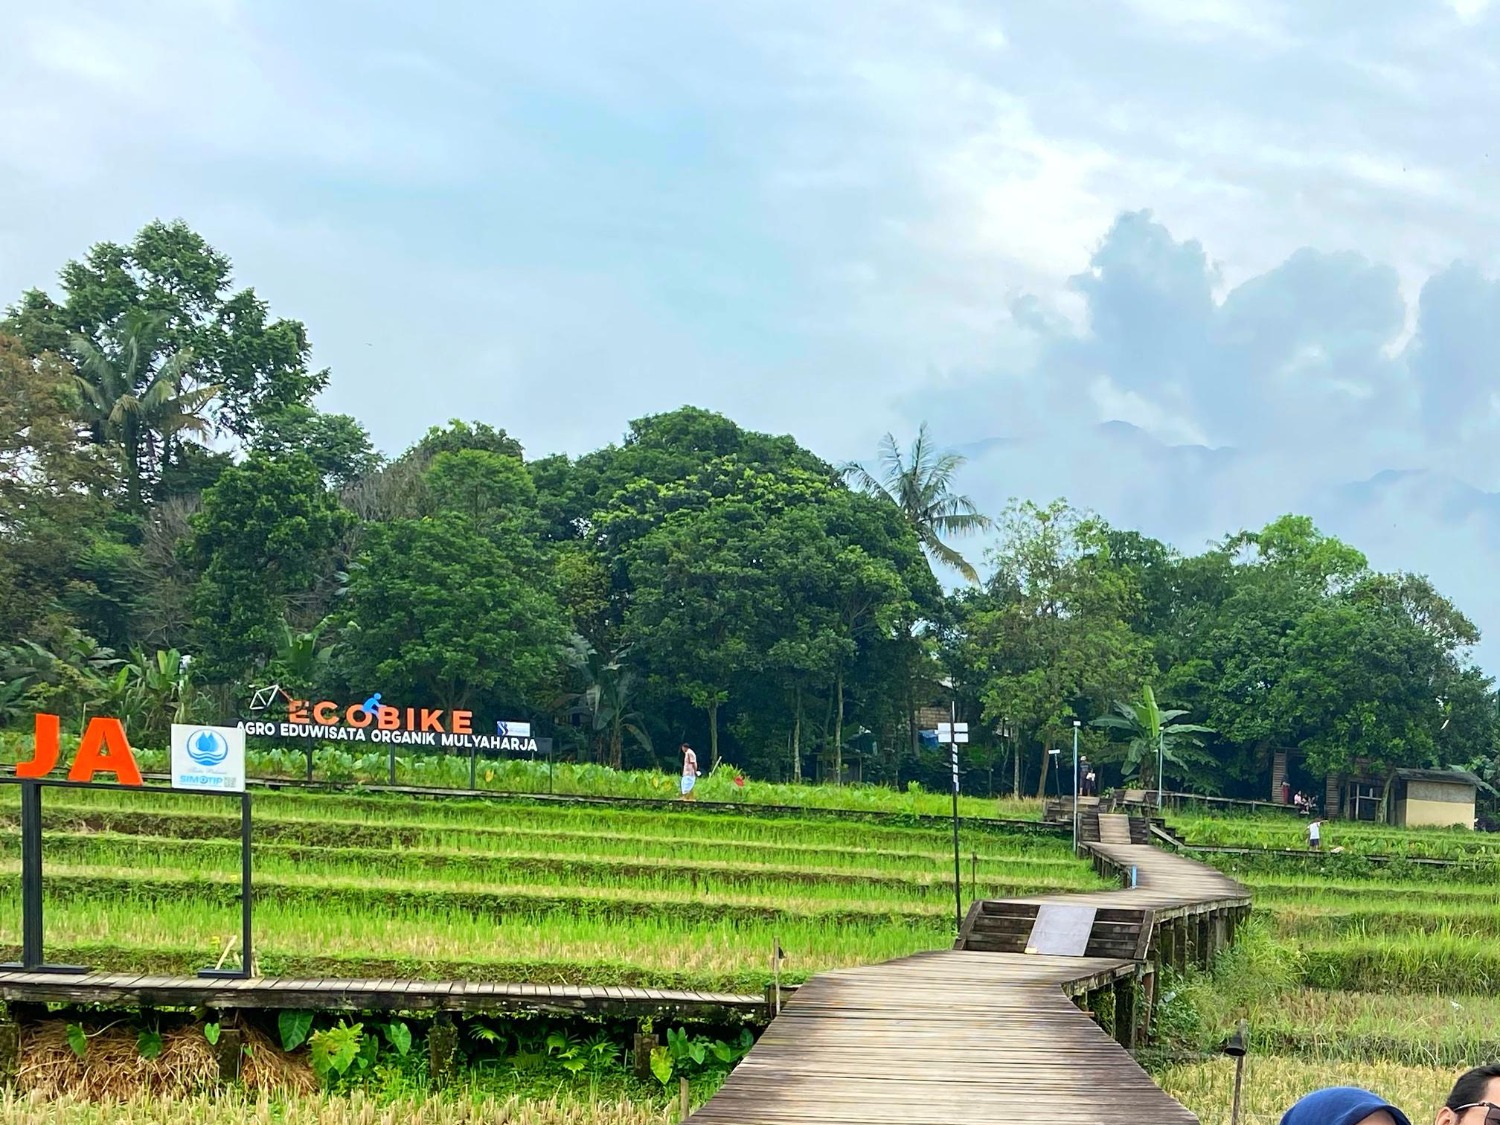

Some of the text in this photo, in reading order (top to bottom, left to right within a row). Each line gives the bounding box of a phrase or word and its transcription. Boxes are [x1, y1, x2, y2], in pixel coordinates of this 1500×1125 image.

[288, 699, 473, 734] ECOBIKE
[16, 713, 143, 786] JA
[237, 721, 538, 752] AGRO EDUWISATA ORGANIK MULYAHARJA
